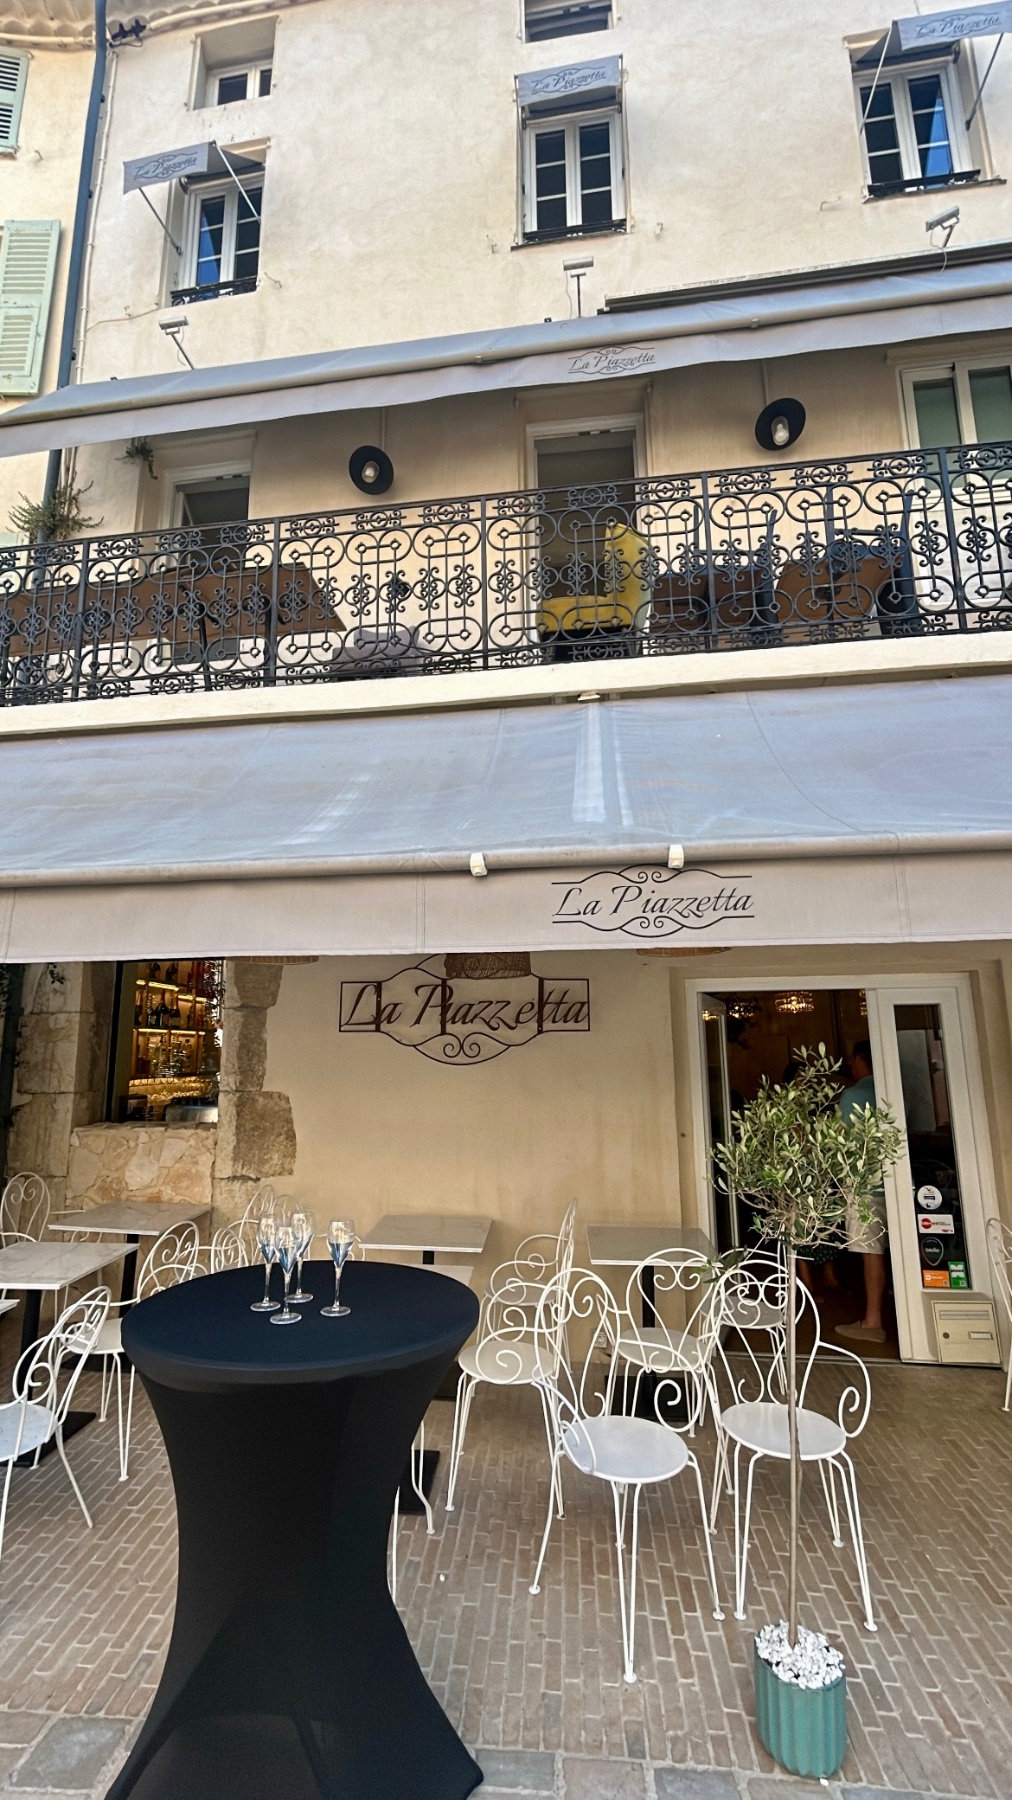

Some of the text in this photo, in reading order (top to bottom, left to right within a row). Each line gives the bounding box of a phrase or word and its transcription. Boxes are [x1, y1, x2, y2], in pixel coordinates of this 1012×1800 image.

[917, 26, 936, 36] La
[532, 70, 607, 92] La Piazzetta
[569, 352, 656, 371] La Piazzetta
[552, 885, 755, 918] La Piazzetta
[342, 984, 402, 1027] La
